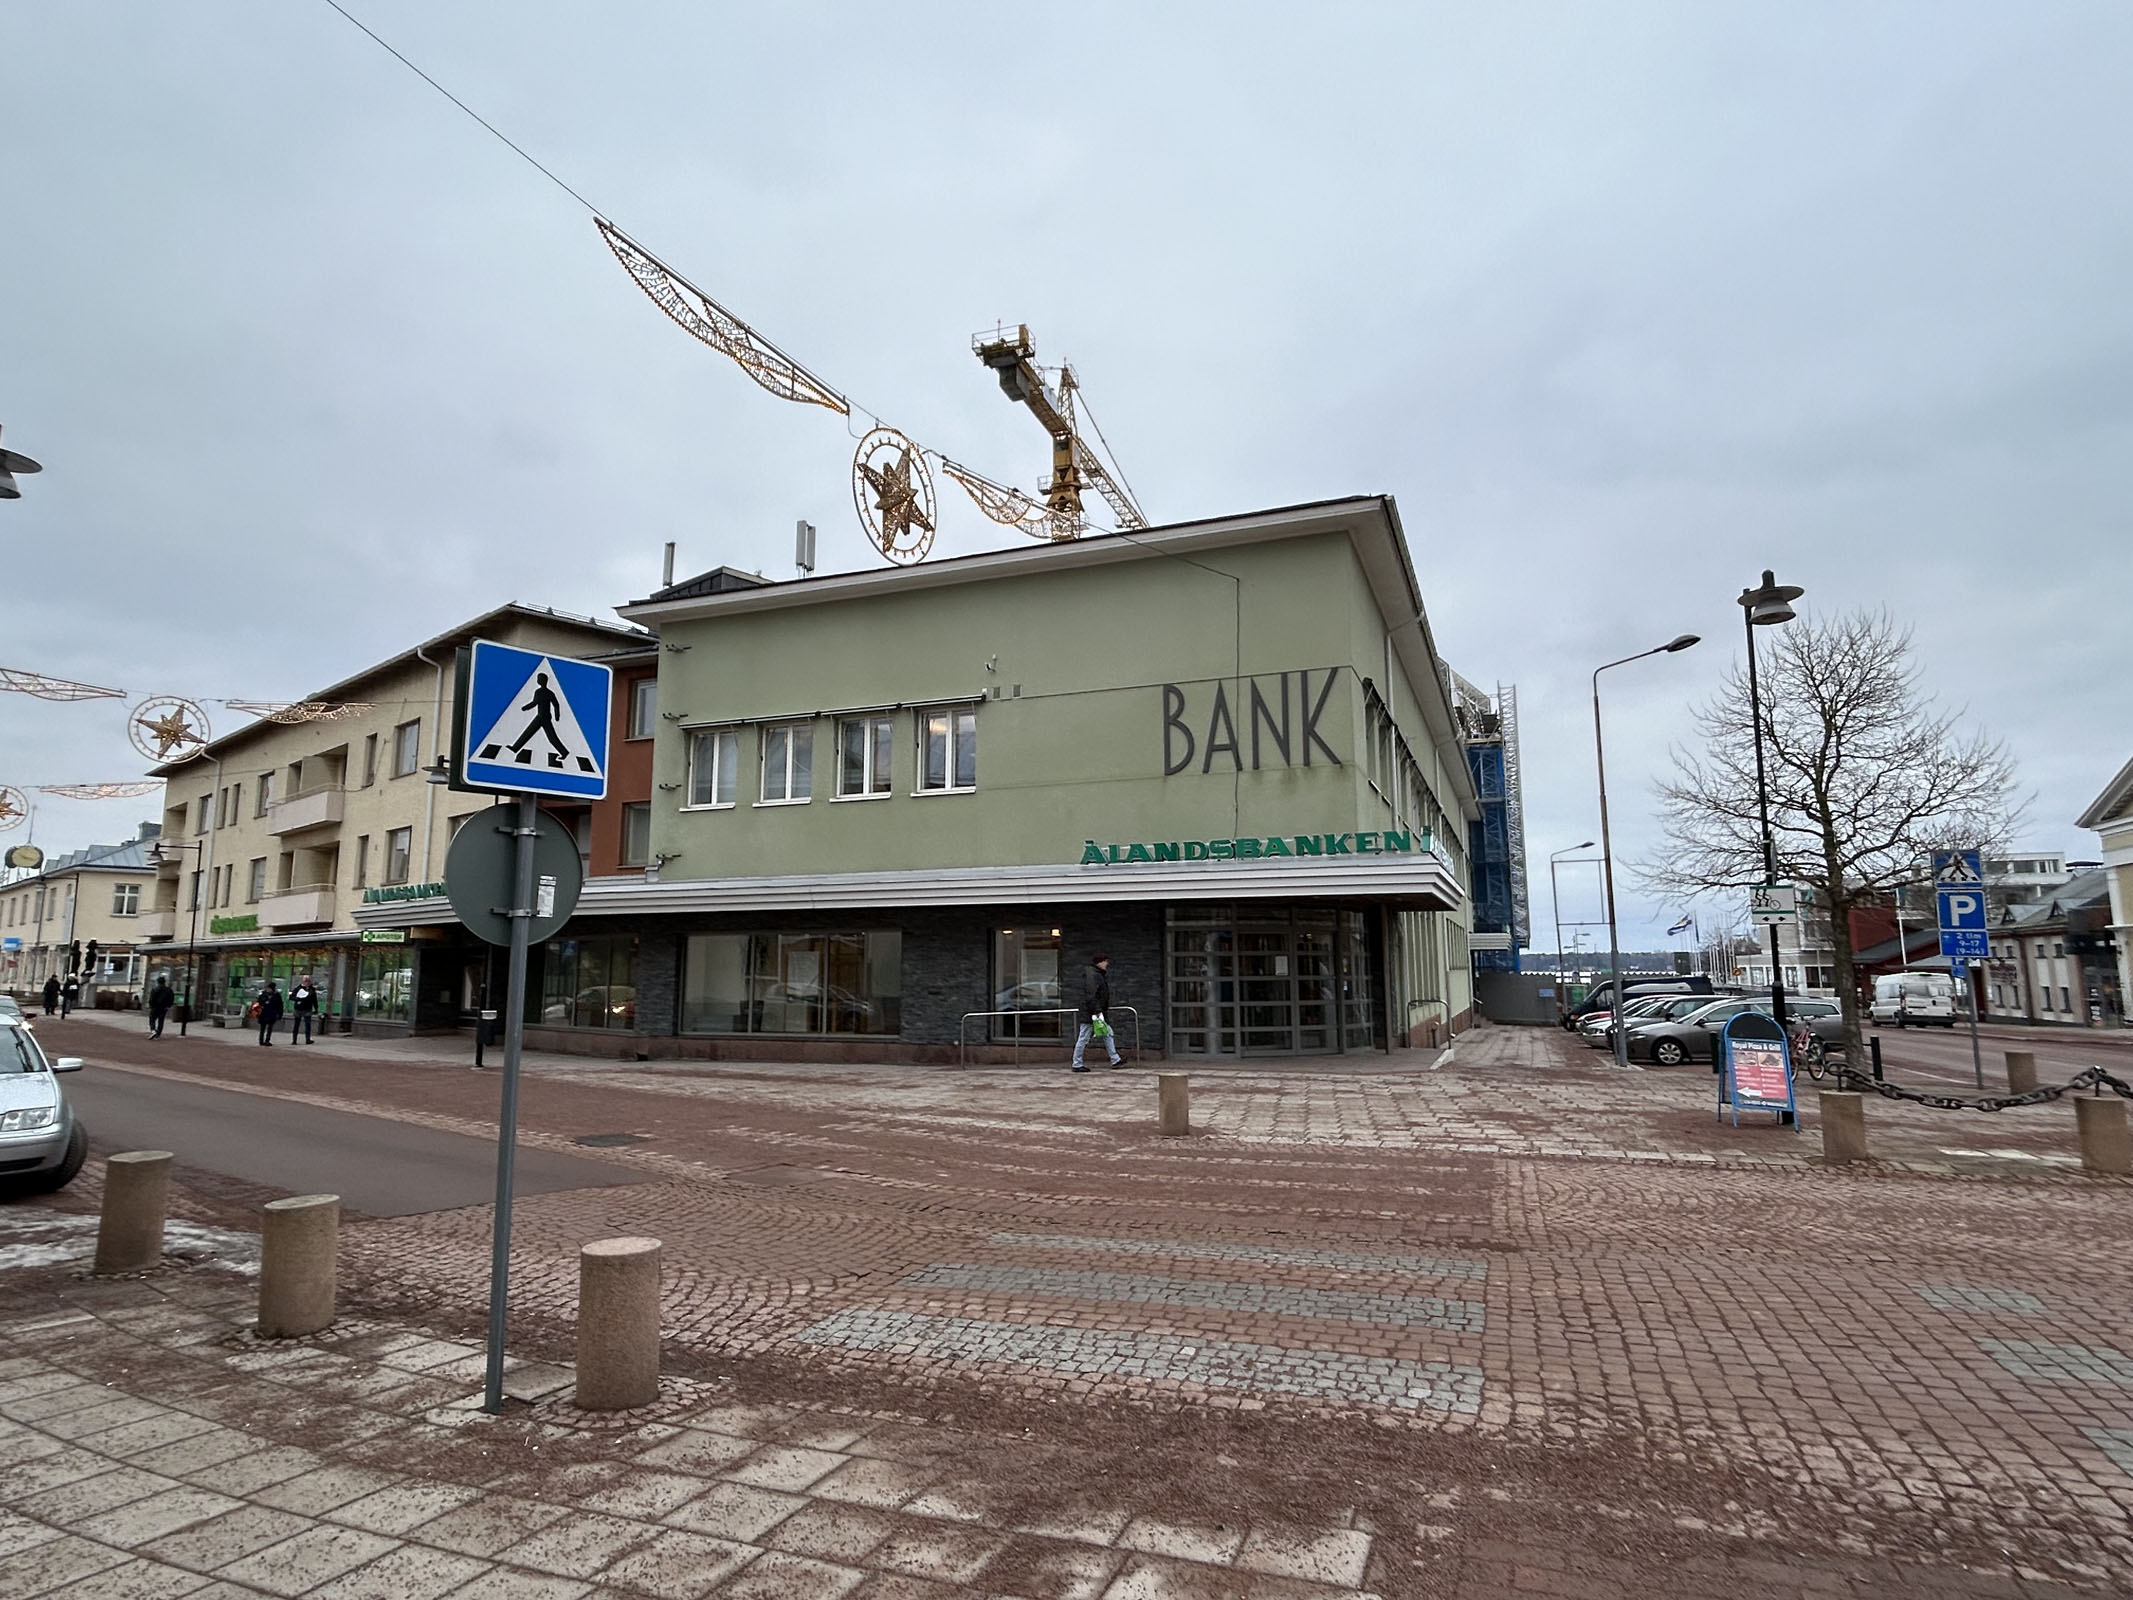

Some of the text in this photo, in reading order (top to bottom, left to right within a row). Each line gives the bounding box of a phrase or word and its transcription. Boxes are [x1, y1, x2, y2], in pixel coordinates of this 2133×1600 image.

[1163, 667, 1341, 776] BANK
[1080, 830, 1411, 866] ÅLANDSBANKEN
[1949, 895, 1977, 926] P
